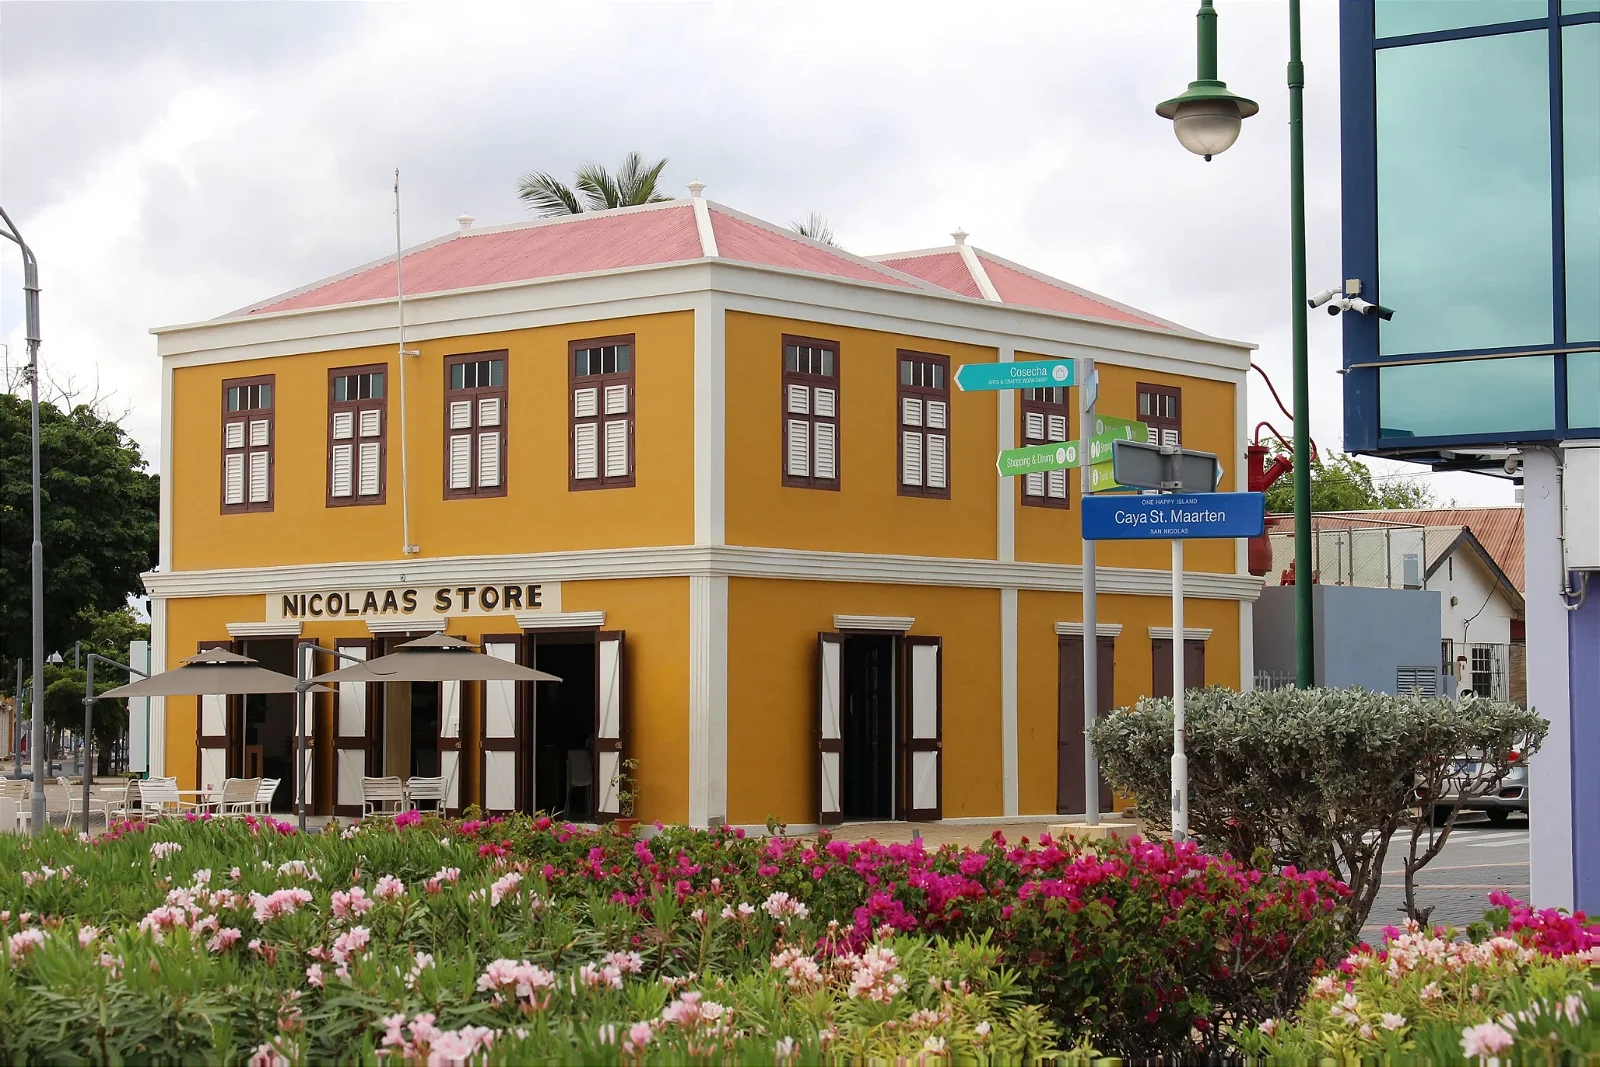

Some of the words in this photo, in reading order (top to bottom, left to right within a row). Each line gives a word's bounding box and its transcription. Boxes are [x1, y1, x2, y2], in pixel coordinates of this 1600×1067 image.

[1010, 366, 1048, 378] Cosecha
[1006, 456, 1031, 468] Shopping
[1031, 455, 1037, 465] &
[1037, 453, 1054, 464] Dining
[1114, 510, 1147, 527] Caya
[1149, 510, 1168, 524] St.
[1170, 509, 1226, 523] Maarten
[282, 588, 418, 618] NICOLAAS
[433, 584, 543, 612] STORE
